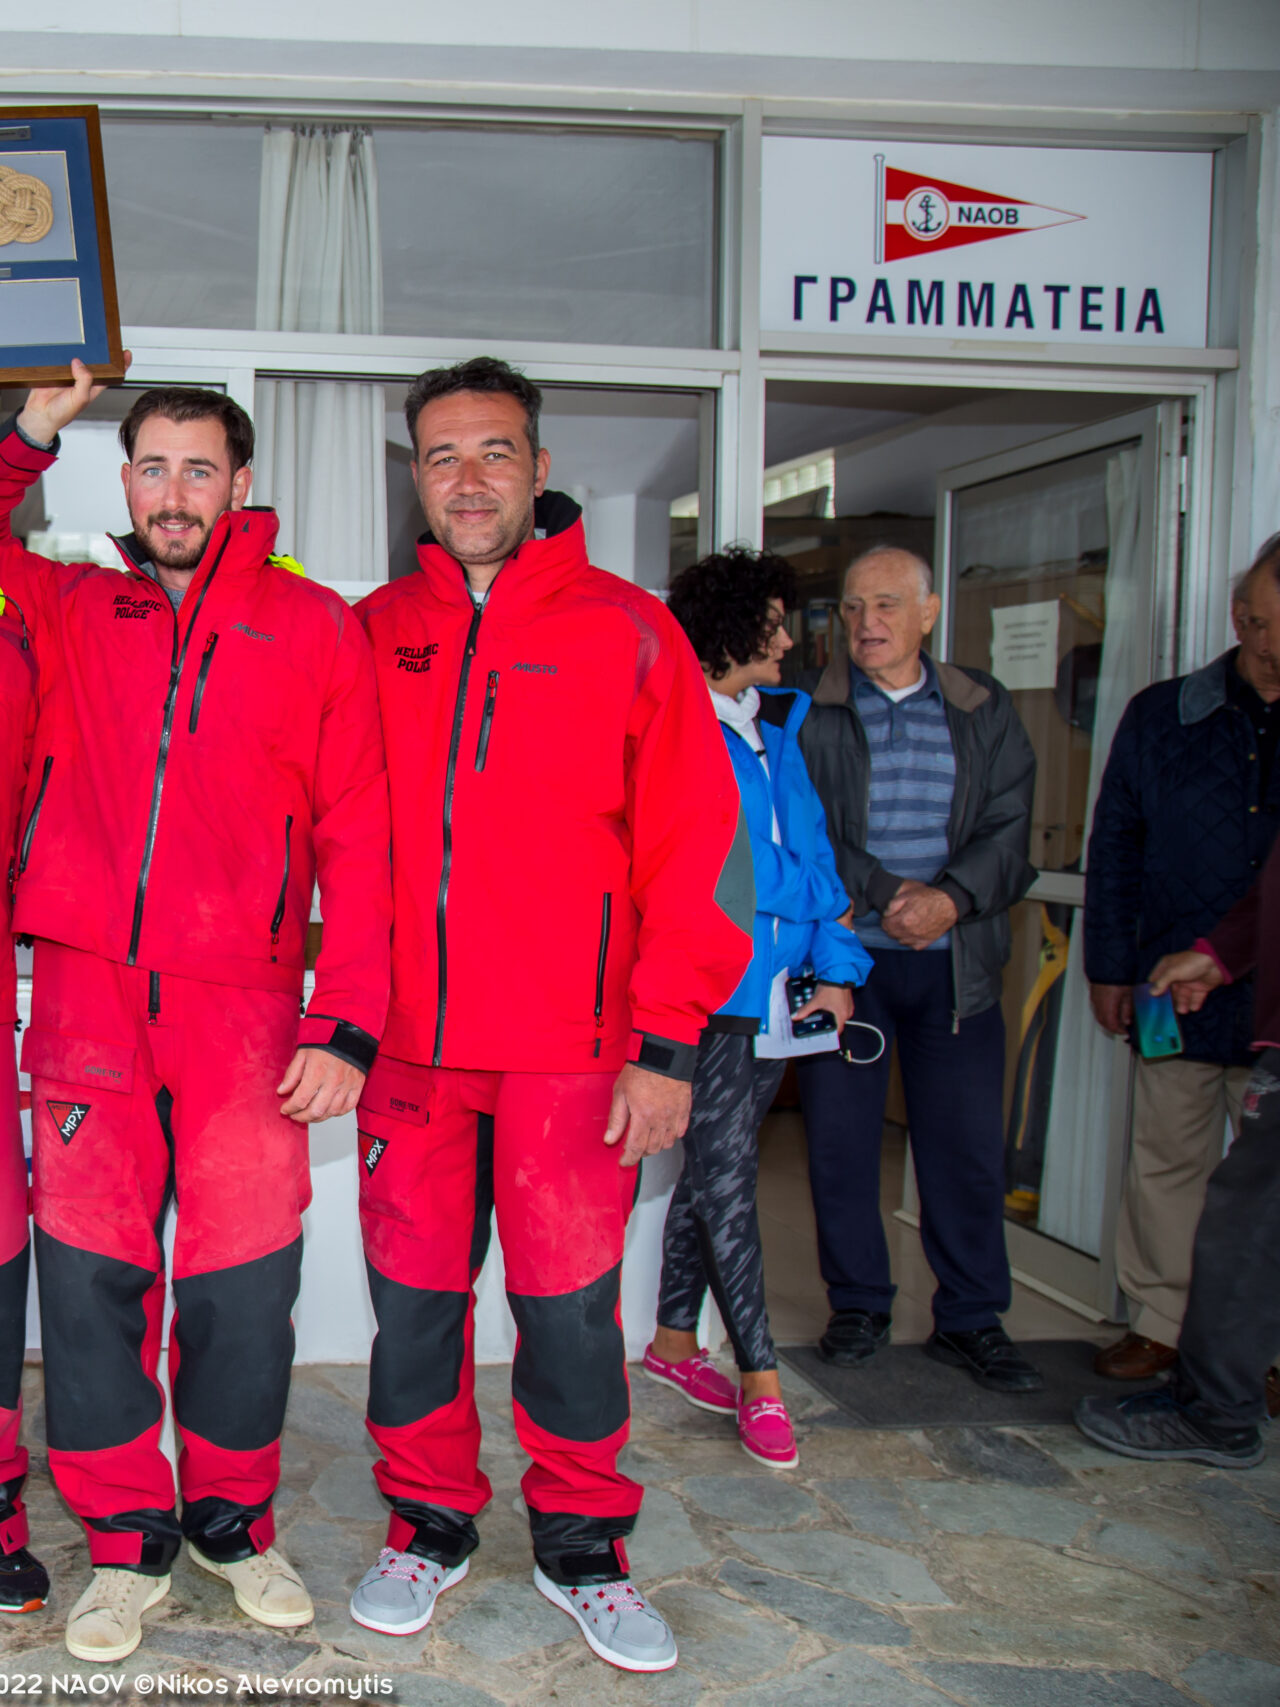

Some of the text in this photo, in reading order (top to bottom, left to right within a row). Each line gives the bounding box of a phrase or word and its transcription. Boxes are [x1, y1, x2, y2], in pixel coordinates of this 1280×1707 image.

[793, 275, 1165, 334] ΓΡΑΜΜΑΤΕΙΑ
[114, 606, 151, 620] POLICE
[230, 622, 275, 642] MUSTO
[510, 662, 558, 675] MUSTO
[61, 1105, 86, 1137] MPX
[365, 1139, 384, 1169] MPX
